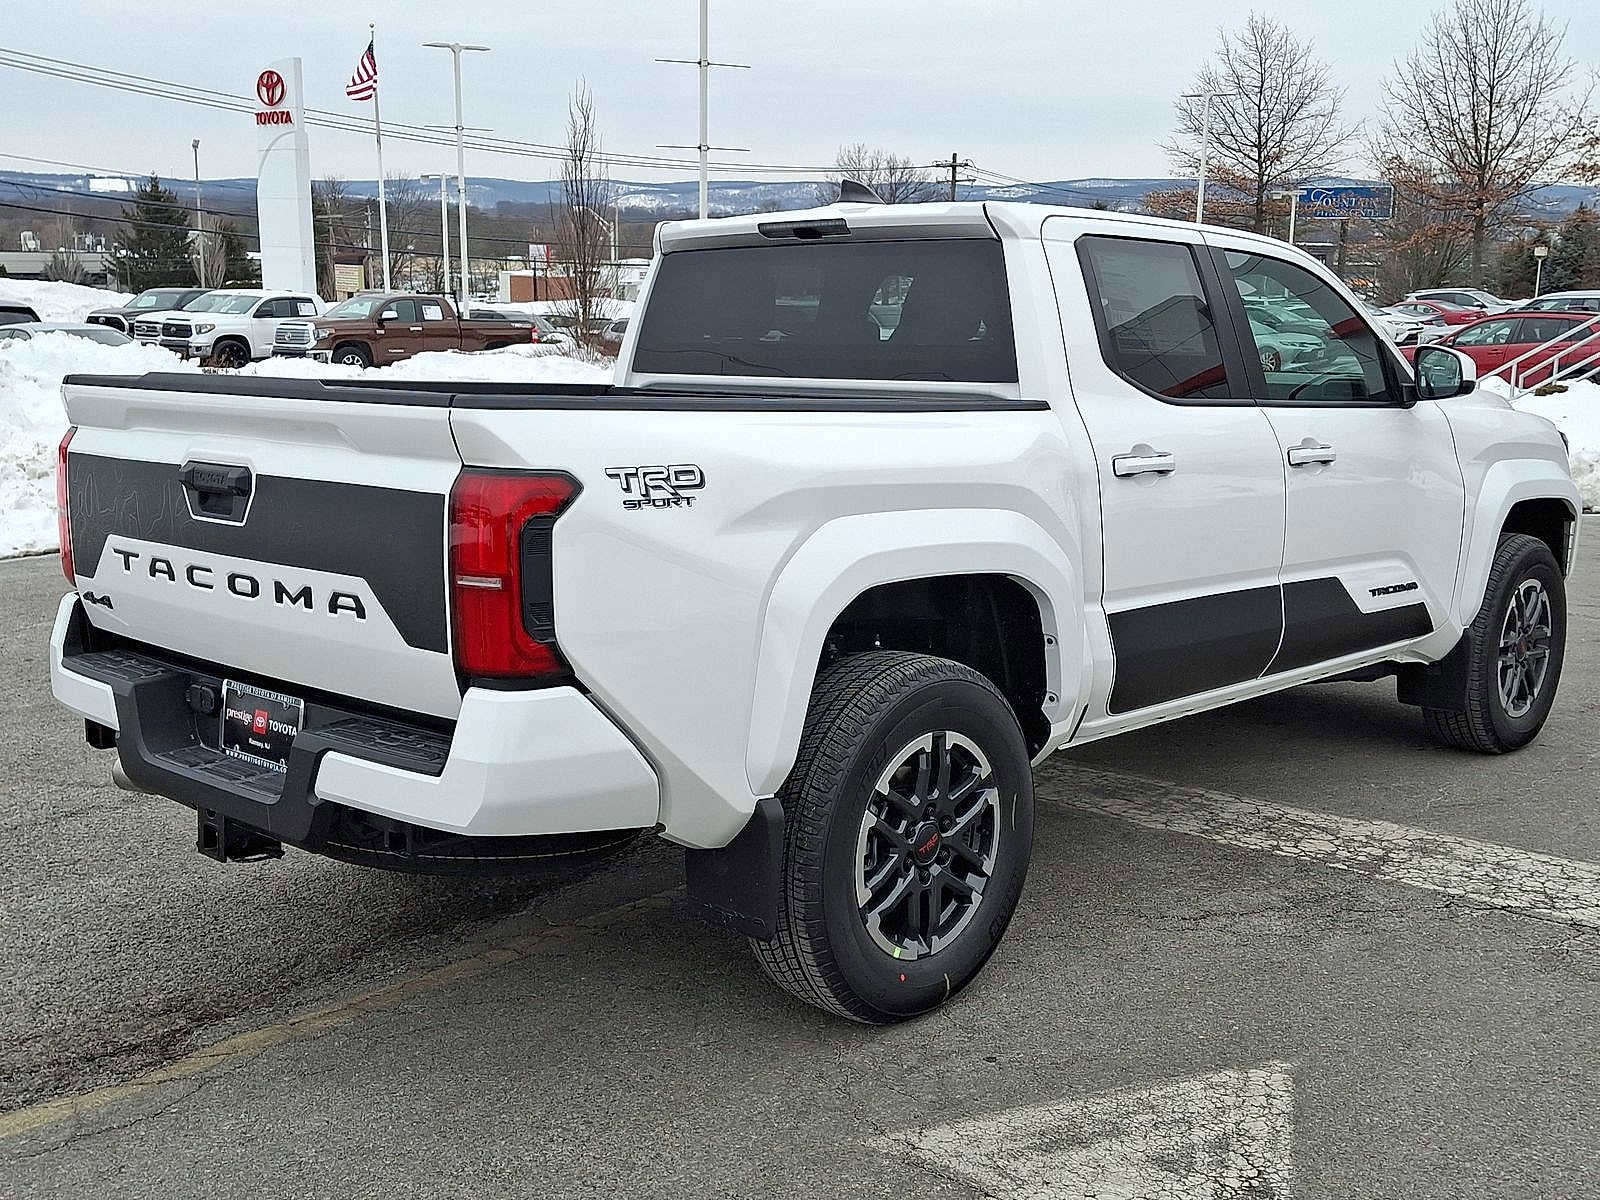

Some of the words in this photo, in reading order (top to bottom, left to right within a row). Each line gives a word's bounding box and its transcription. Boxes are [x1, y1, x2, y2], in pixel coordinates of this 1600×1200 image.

[254, 110, 293, 126] TOYOTA
[605, 464, 706, 497] TRD
[622, 496, 697, 511] SPORT
[111, 547, 367, 621] TACOMA
[1368, 581, 1419, 597] TACOMA
[252, 688, 270, 698] TOYOTA
[225, 708, 253, 725] prestige
[268, 719, 298, 737] TOYOTA
[918, 831, 940, 854] TRD
